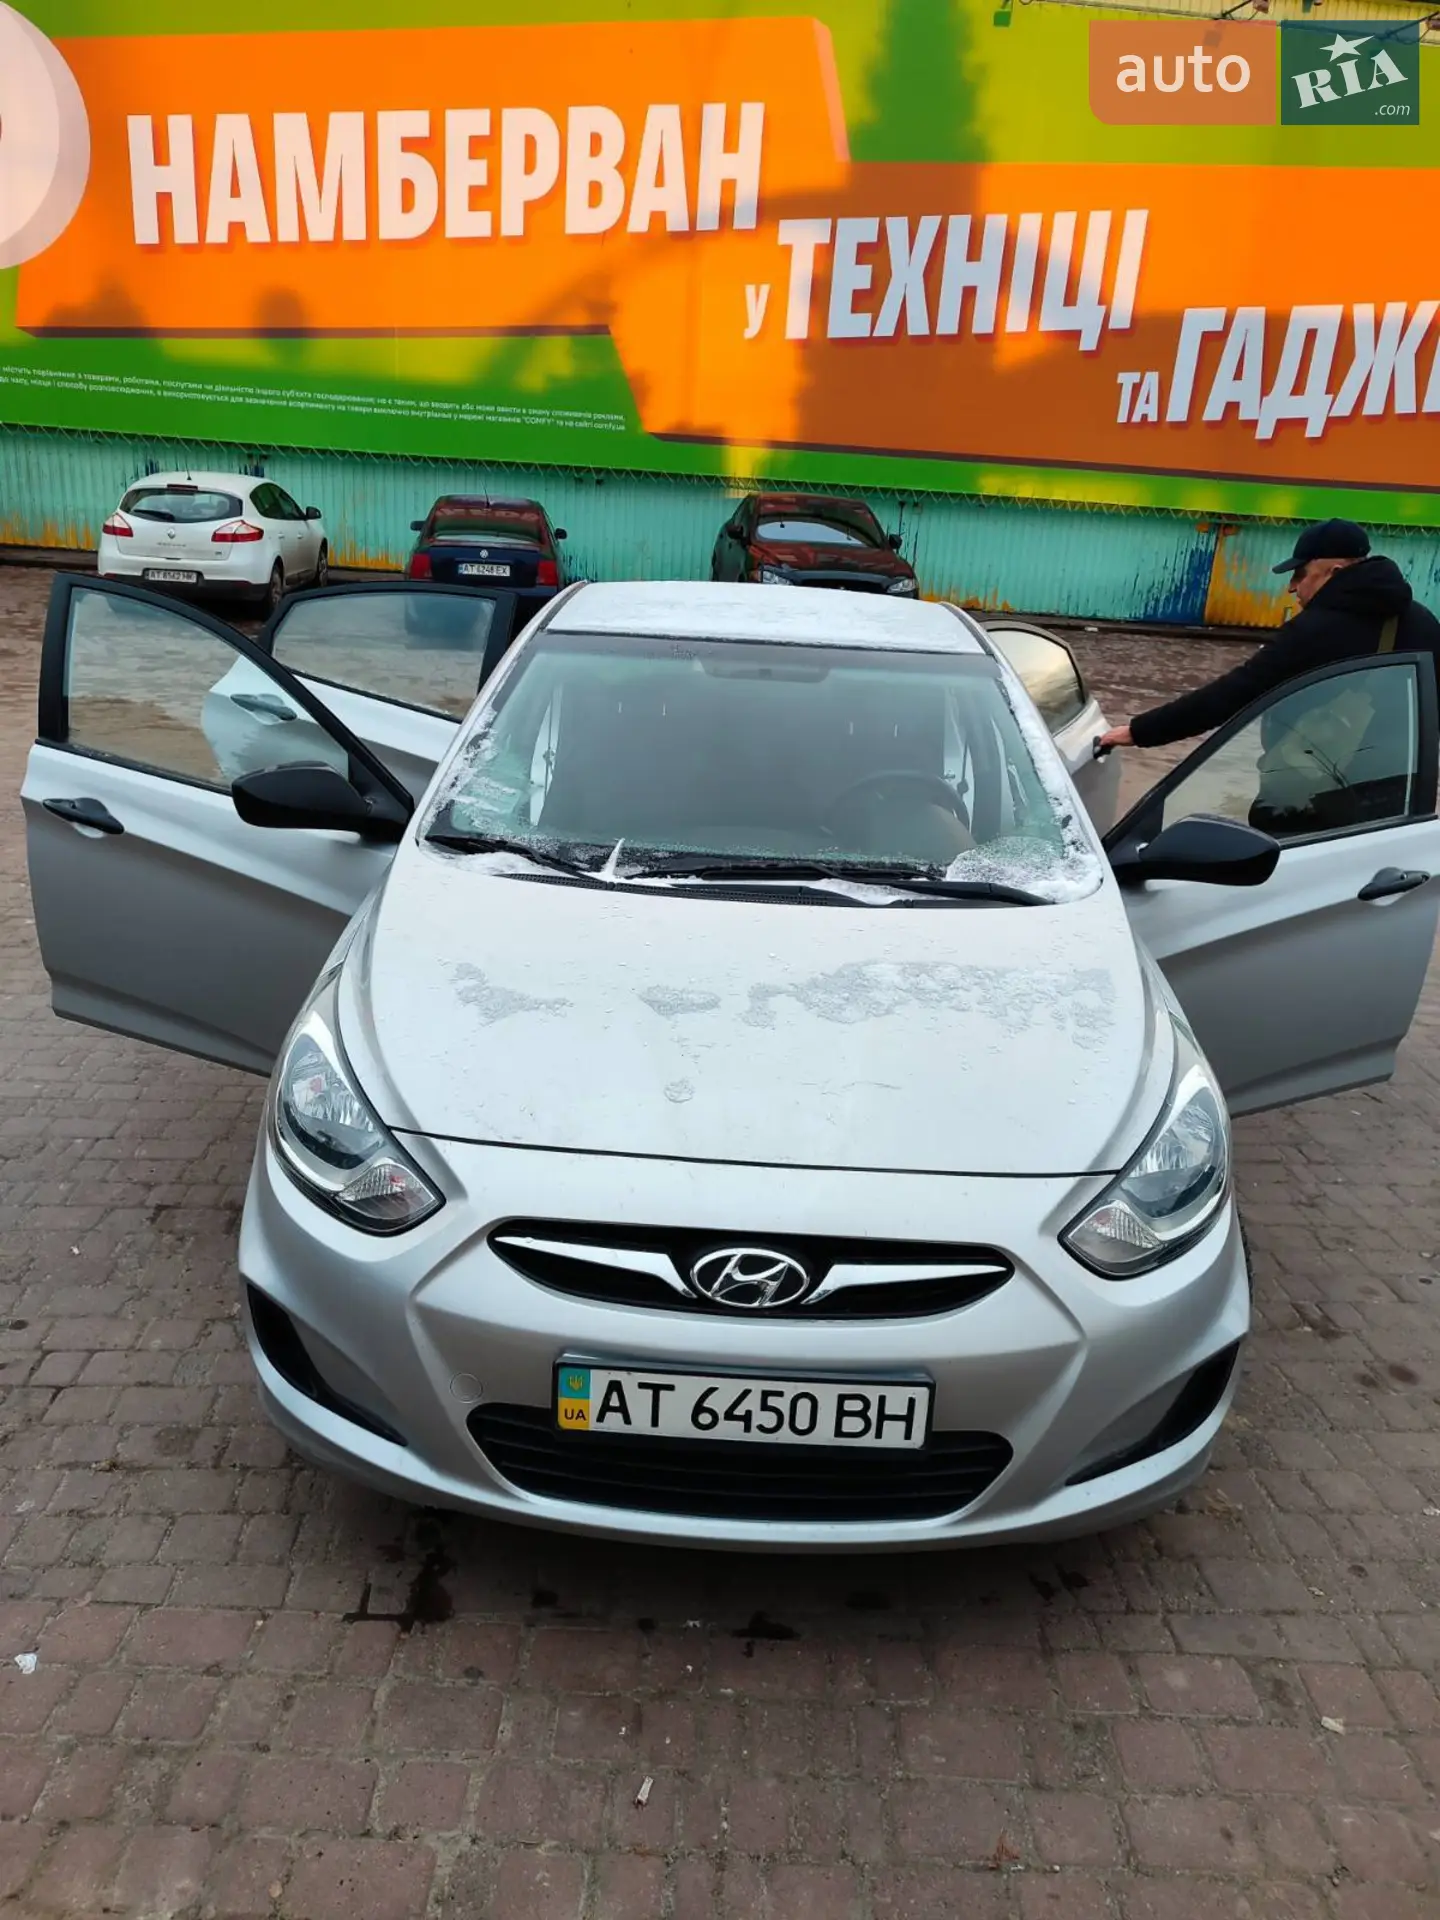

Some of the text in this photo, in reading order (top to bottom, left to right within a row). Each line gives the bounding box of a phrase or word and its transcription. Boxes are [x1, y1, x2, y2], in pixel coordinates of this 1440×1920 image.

[126, 102, 765, 245] НАМБЕРВАН
[777, 209, 1150, 351] ТЕХНІЦІ
[1116, 371, 1159, 423] ТА
[564, 1408, 587, 1421] UA
[596, 1379, 916, 1441] AT 6450 BH
